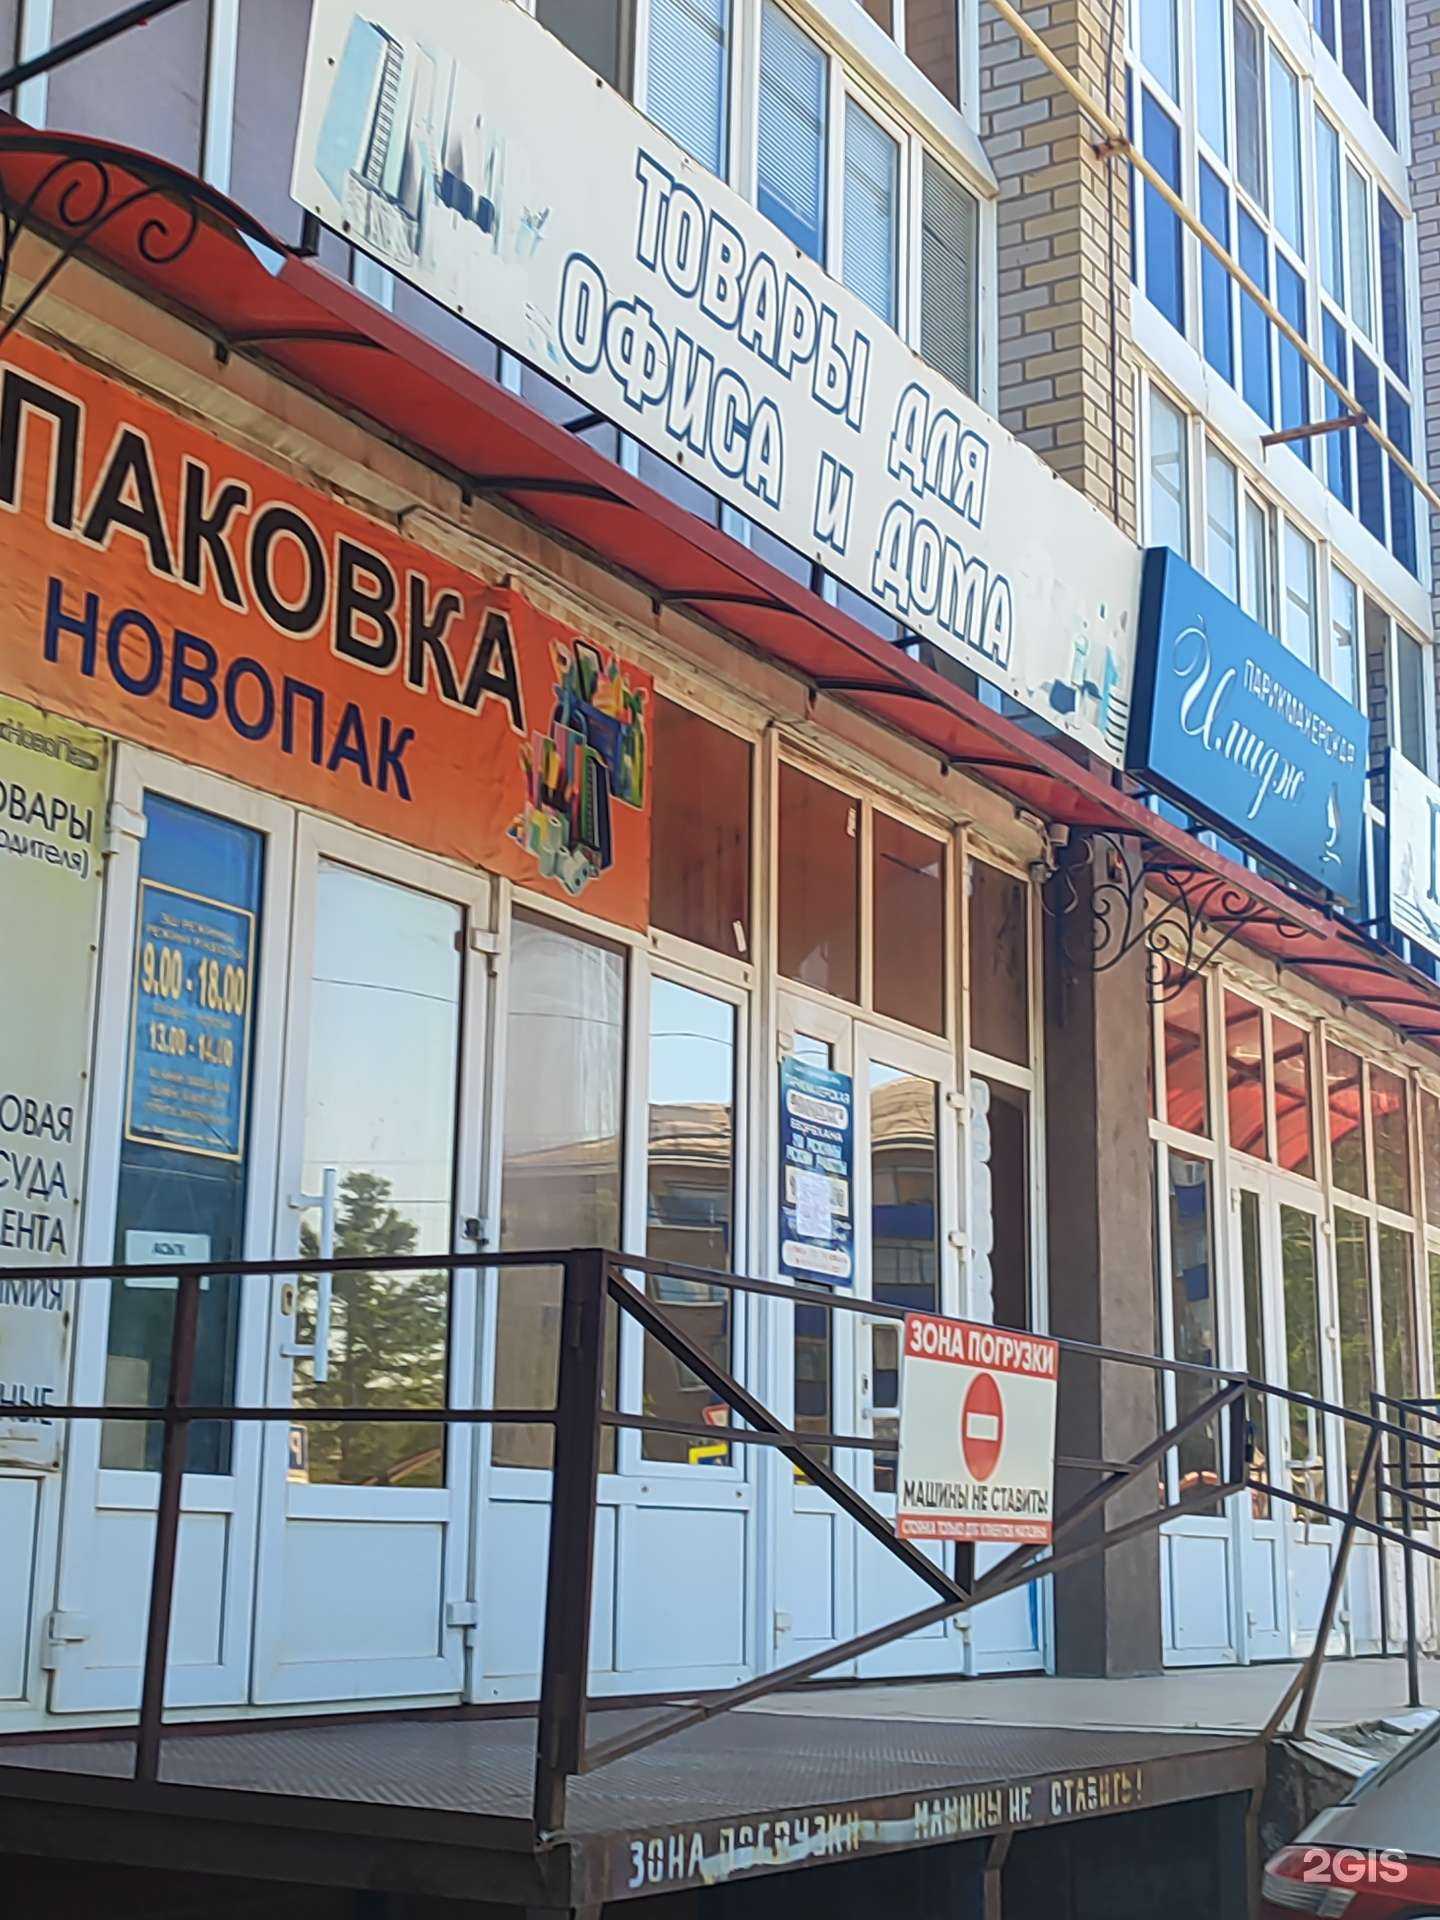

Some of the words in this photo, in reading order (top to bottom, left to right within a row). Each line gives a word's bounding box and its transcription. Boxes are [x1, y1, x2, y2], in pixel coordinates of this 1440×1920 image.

[635, 147, 872, 433] ТОВАРЫ
[887, 382, 989, 530] ДЛЯ
[558, 251, 784, 510] ОФИСА
[813, 451, 854, 556] И
[871, 498, 1014, 671] ДОМА
[0, 366, 527, 734] ПАКОВКА
[44, 576, 415, 802] НОВОПАК
[0, 1094, 73, 1143] ОВАЯ
[1, 1208, 67, 1255] ЕНТА
[910, 1320, 964, 1361] ЗОНА
[967, 1331, 1054, 1375] ПОГРУЗКИ
[903, 1480, 969, 1510] МАШИНЫ
[971, 1485, 988, 1511] НЕ
[628, 1832, 703, 1889] ЗОНА
[1008, 1786, 1033, 1824] НЕ
